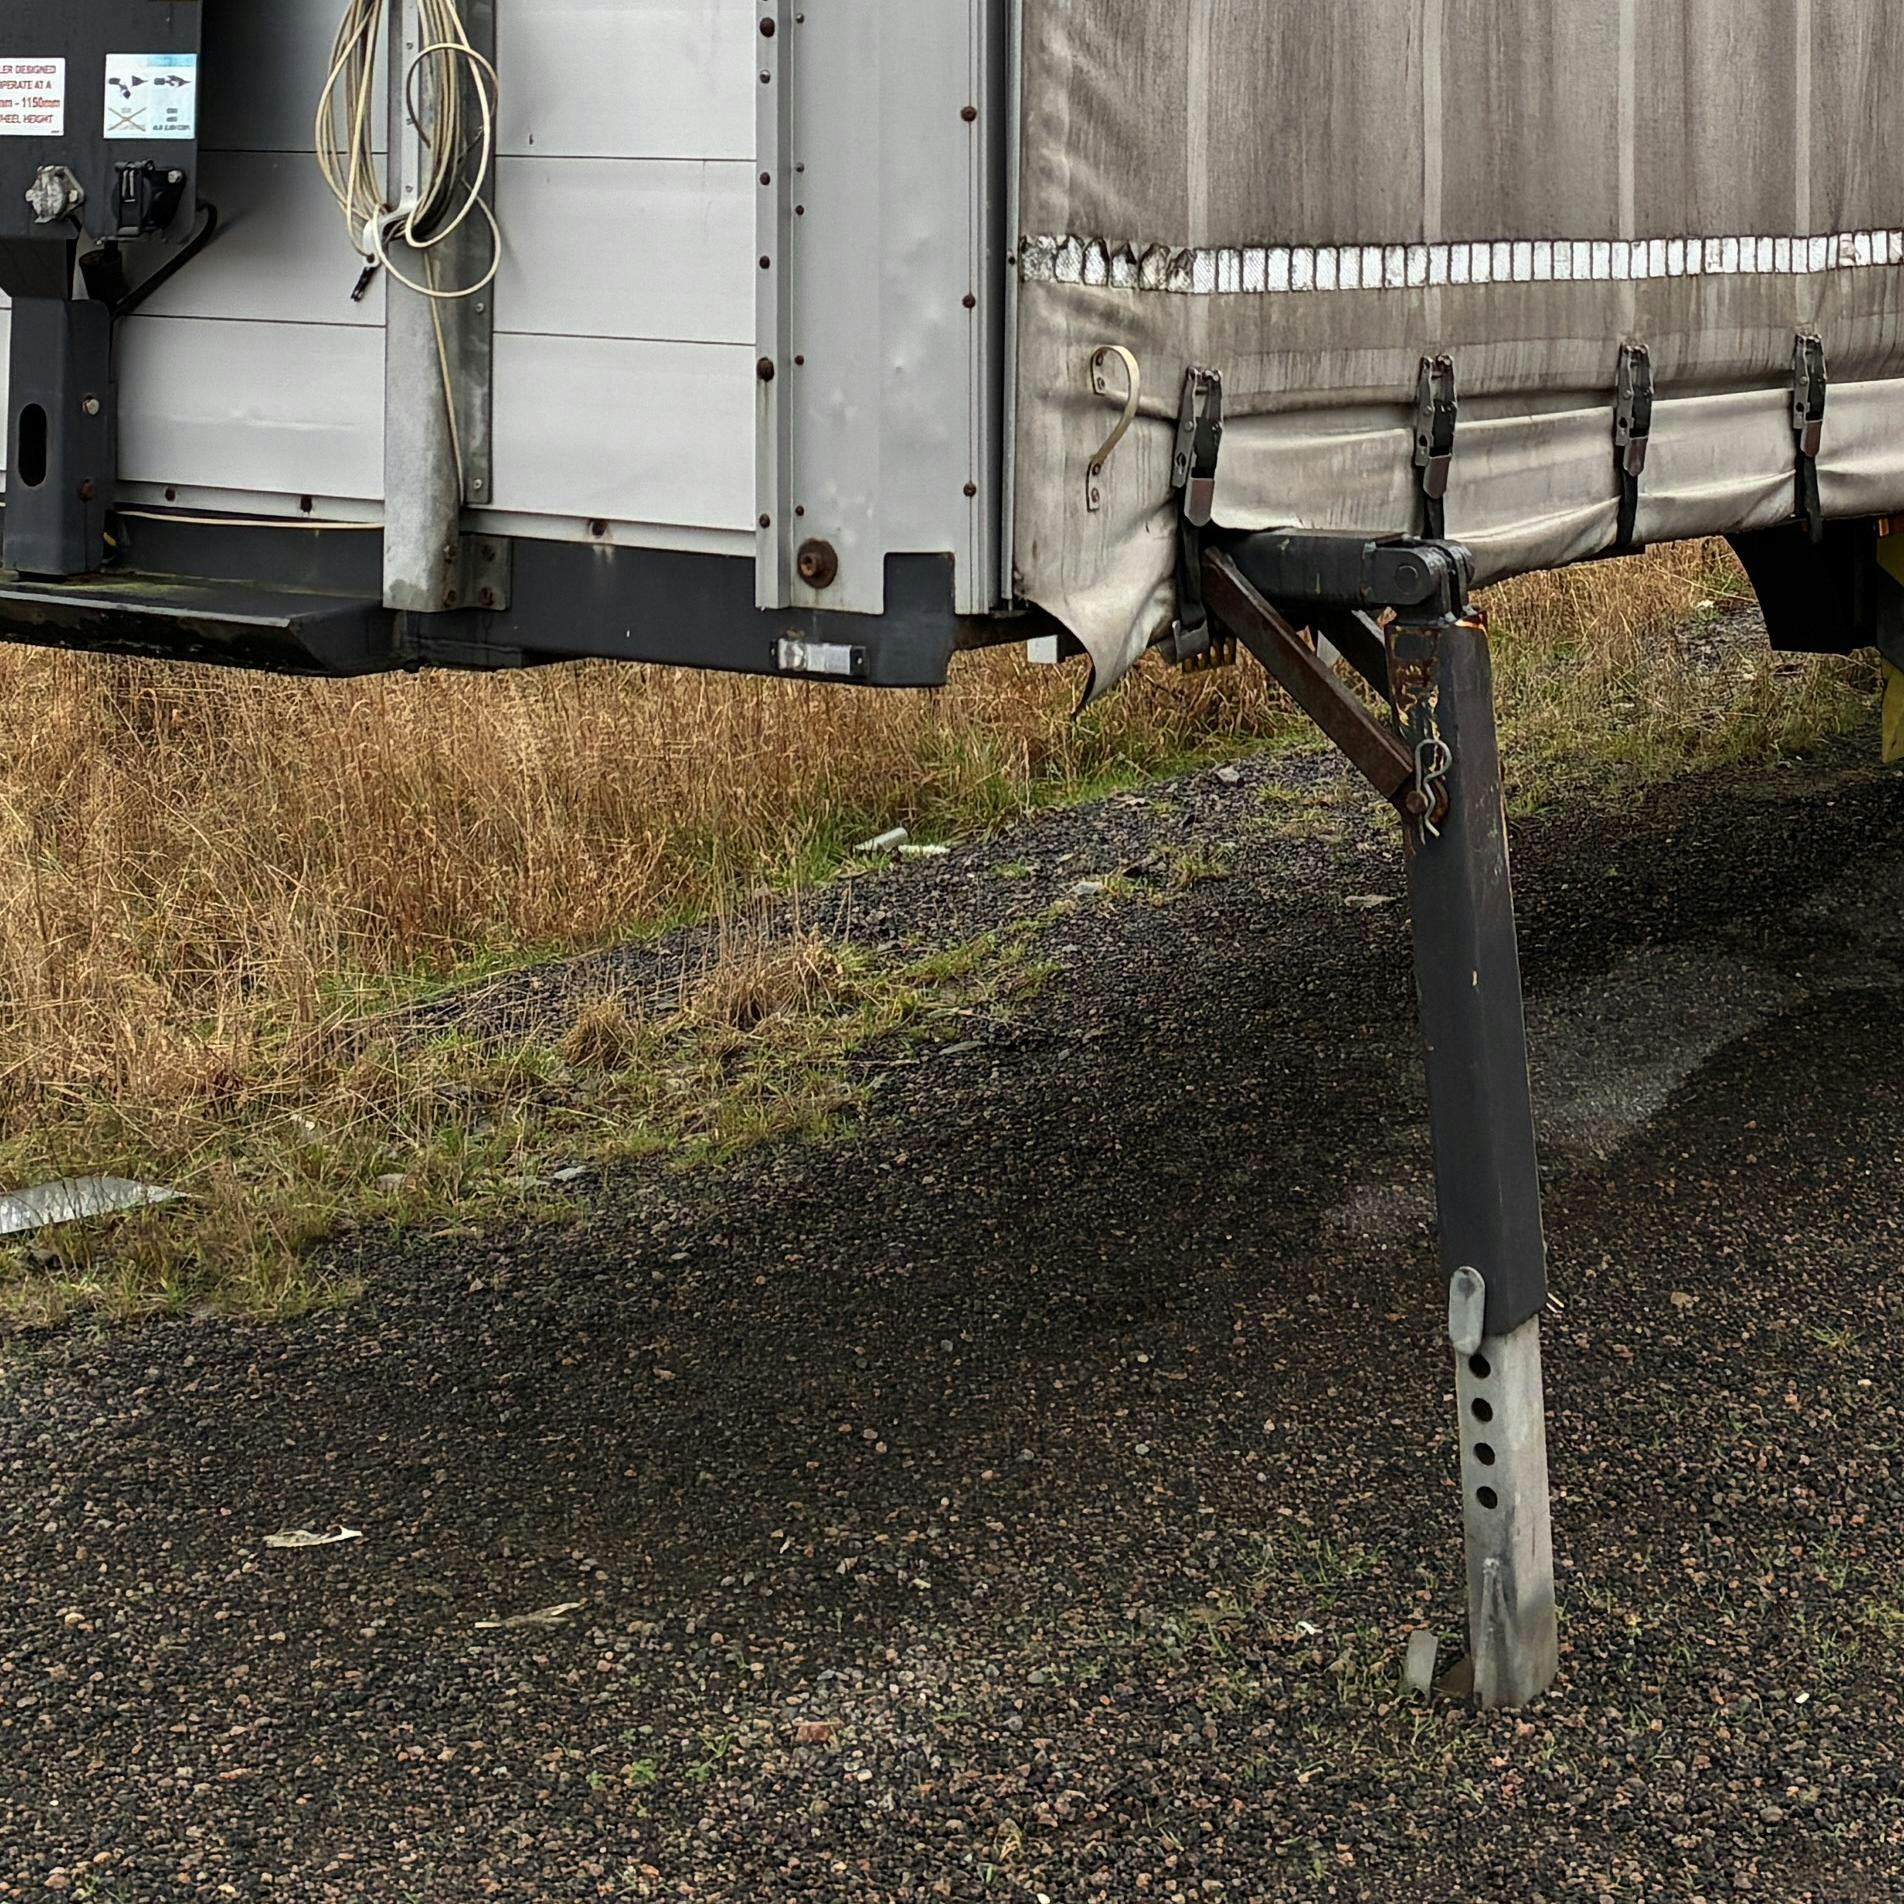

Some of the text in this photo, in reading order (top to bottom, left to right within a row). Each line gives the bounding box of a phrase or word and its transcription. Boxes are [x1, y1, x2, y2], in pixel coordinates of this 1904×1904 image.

[15, 65, 57, 74] DESIGNED
[34, 80, 44, 90] AT
[45, 80, 52, 90] A
